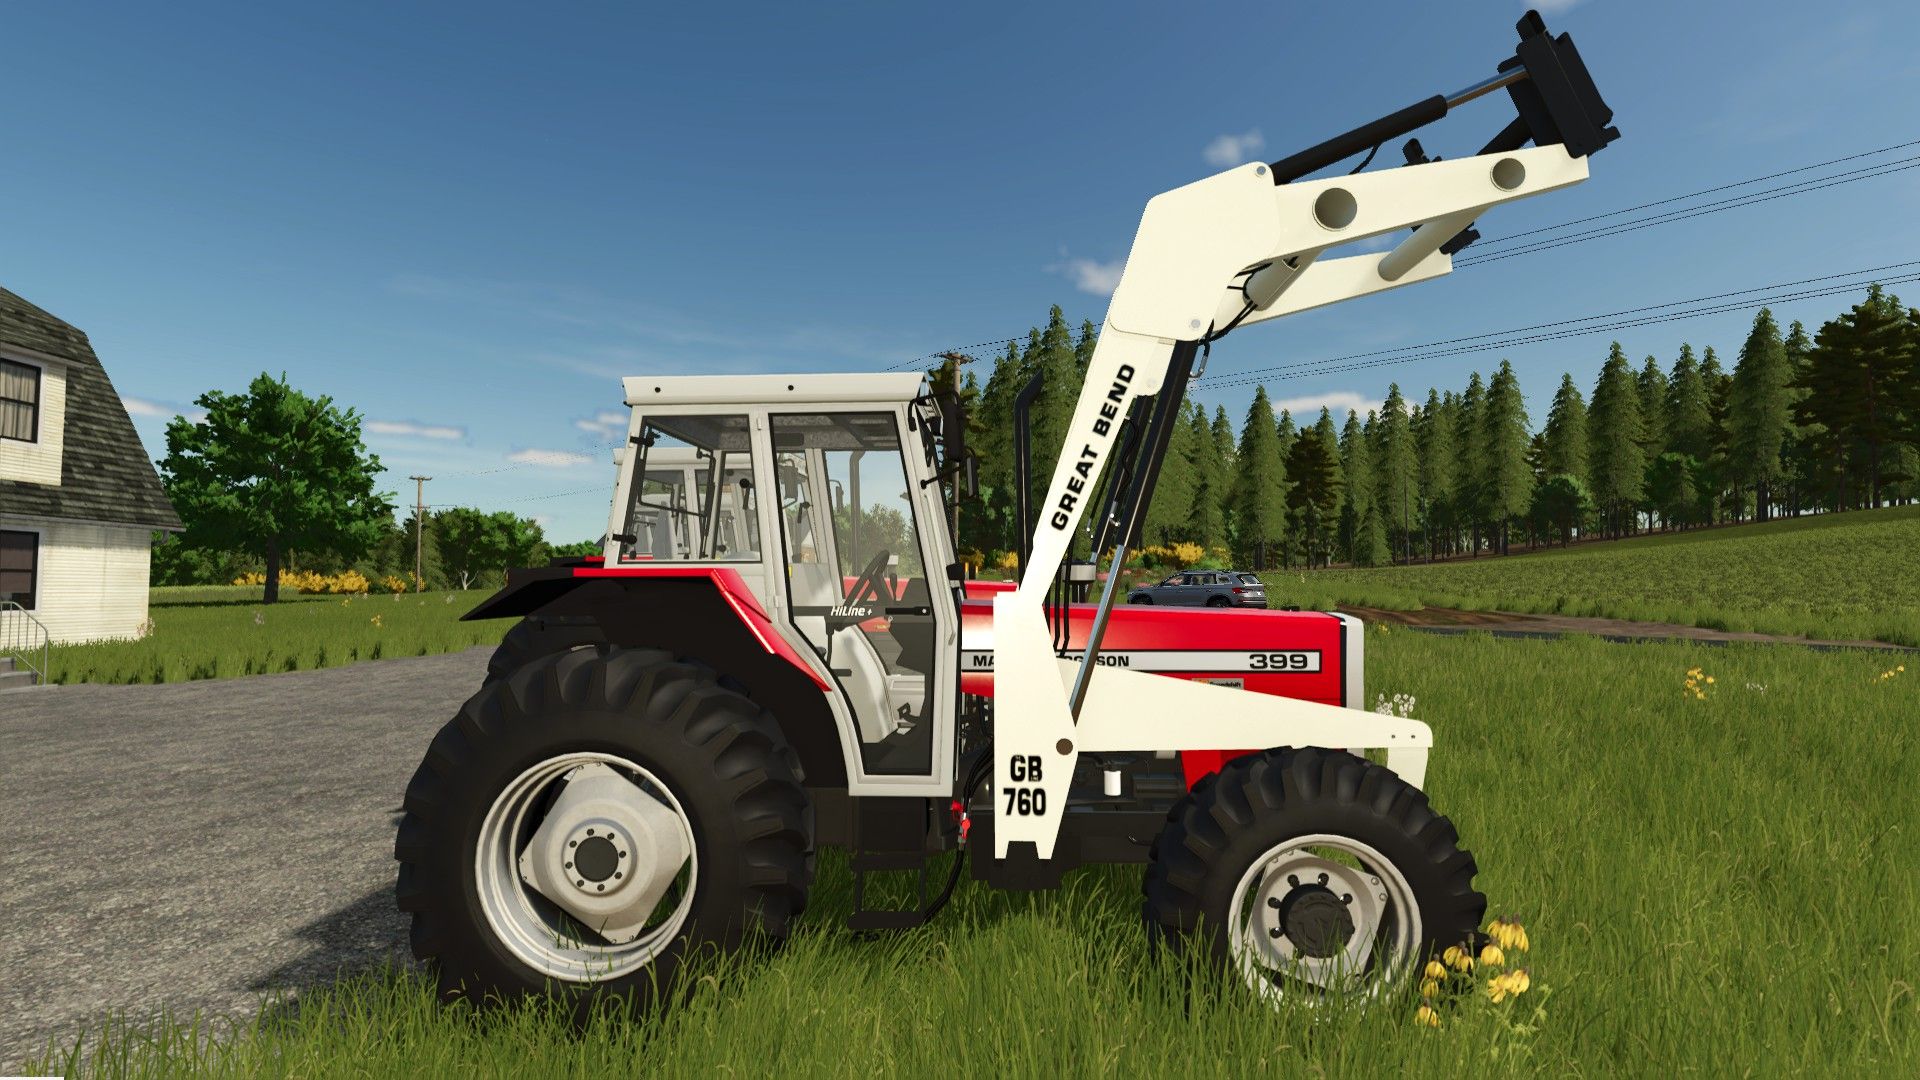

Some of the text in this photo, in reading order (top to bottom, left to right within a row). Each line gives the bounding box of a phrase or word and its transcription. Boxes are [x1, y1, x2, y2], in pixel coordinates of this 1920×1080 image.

[1051, 364, 1135, 531] GREAT BEND
[1249, 654, 1308, 669] 399
[1010, 754, 1043, 783] GB
[1003, 787, 1047, 816] 760
